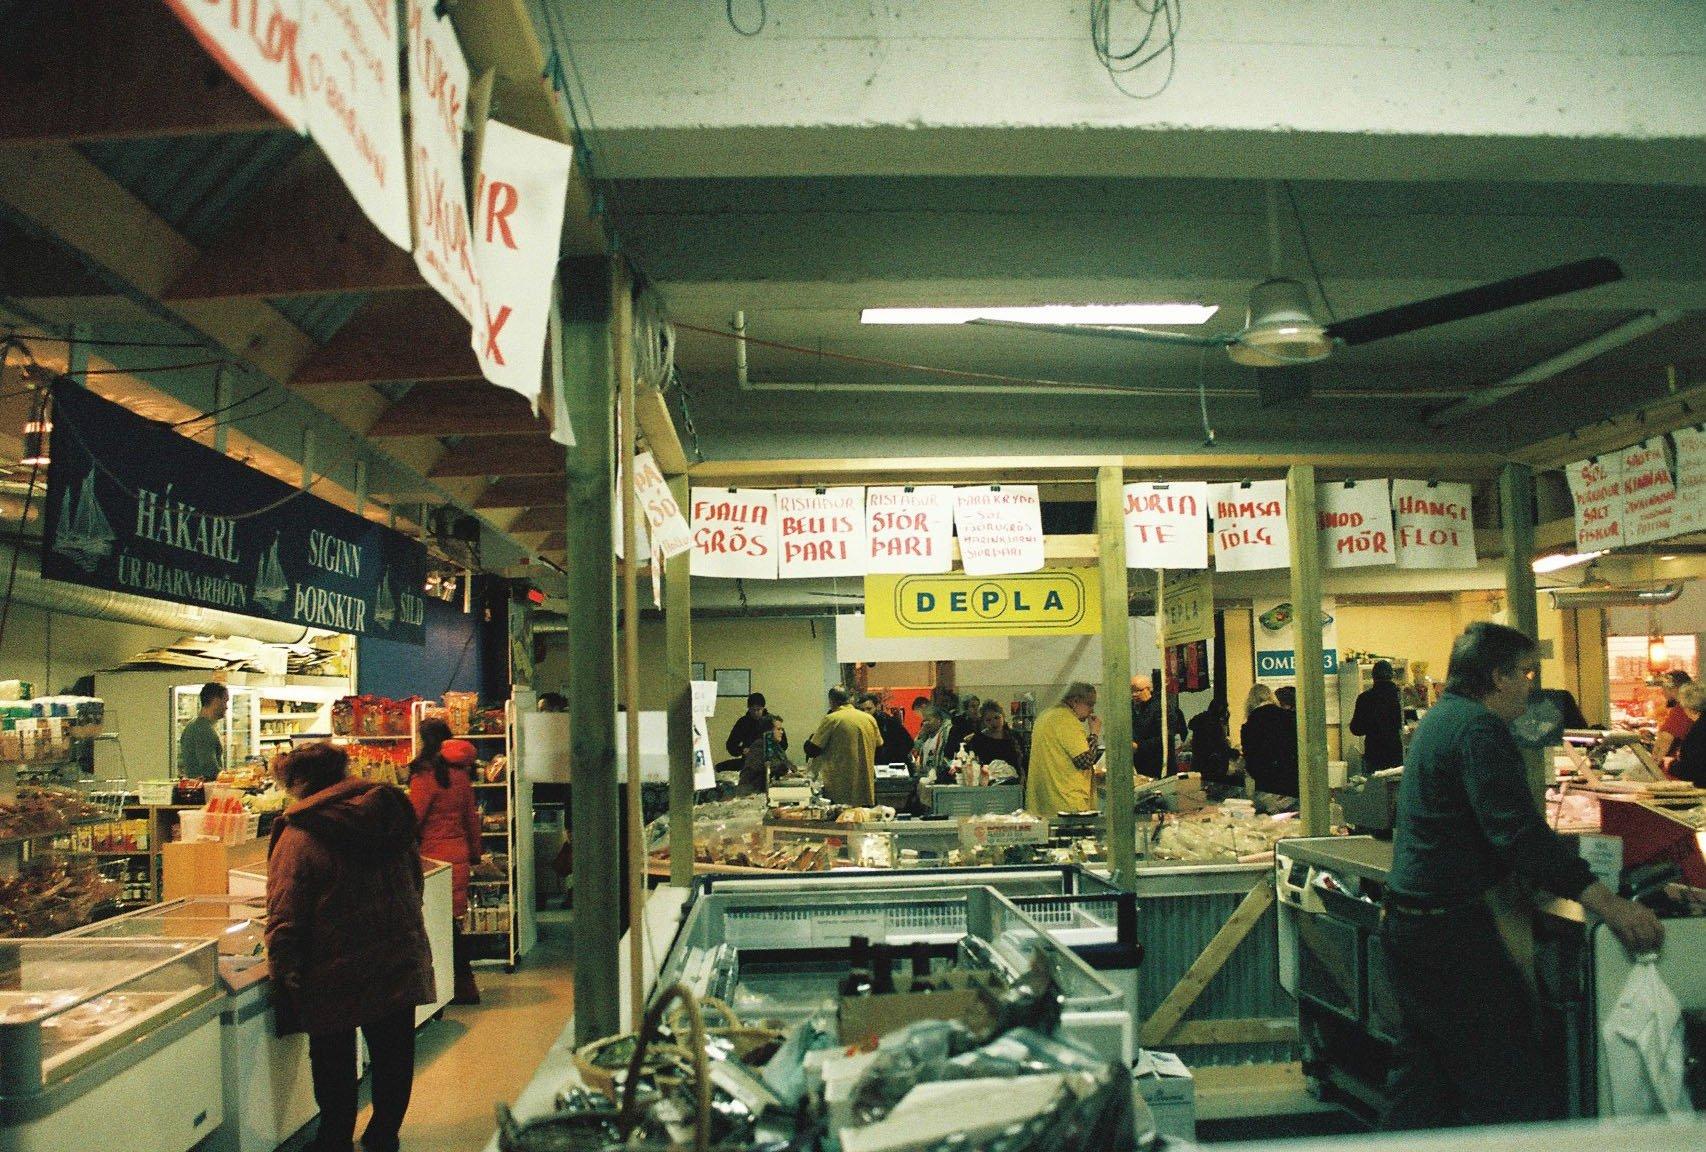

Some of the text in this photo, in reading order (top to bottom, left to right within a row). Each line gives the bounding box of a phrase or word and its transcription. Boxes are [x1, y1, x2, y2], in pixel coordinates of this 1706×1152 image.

[694, 501, 769, 526] FJALLA
[1217, 501, 1281, 519] HAMSA
[135, 482, 240, 564] HÁKARL
[1133, 524, 1175, 544] TE
[308, 528, 362, 579] SIGINN
[784, 540, 847, 563] ÞARI
[872, 537, 932, 557] ÞARI
[293, 582, 366, 632] ÞORSKUR
[917, 590, 1065, 613] DEPLA
[1323, 654, 1333, 669] 3
